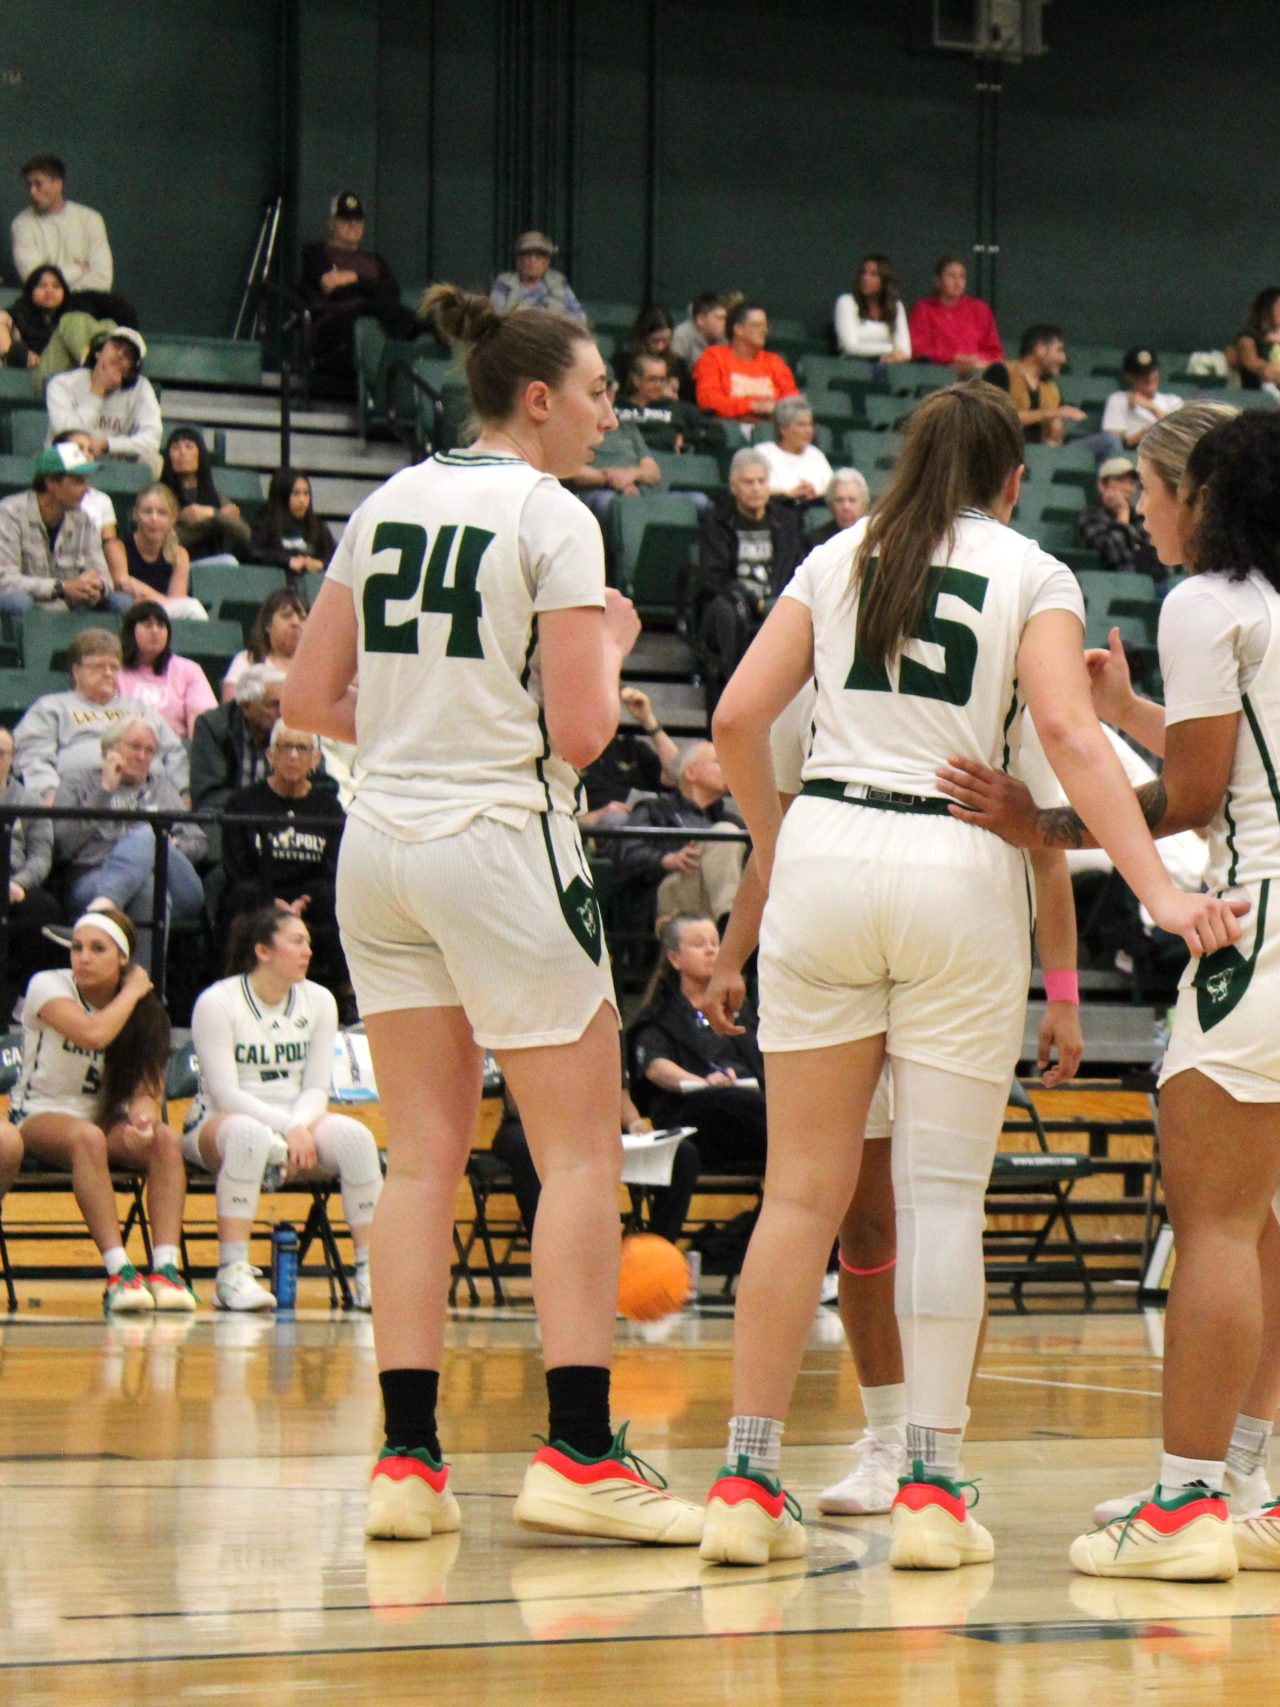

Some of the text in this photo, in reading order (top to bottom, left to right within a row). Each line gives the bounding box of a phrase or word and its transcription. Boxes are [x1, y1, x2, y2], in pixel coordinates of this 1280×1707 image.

[362, 521, 497, 660] 24
[843, 556, 990, 707] 15
[2, 1046, 23, 1067] CA
[235, 1042, 270, 1065] CAL
